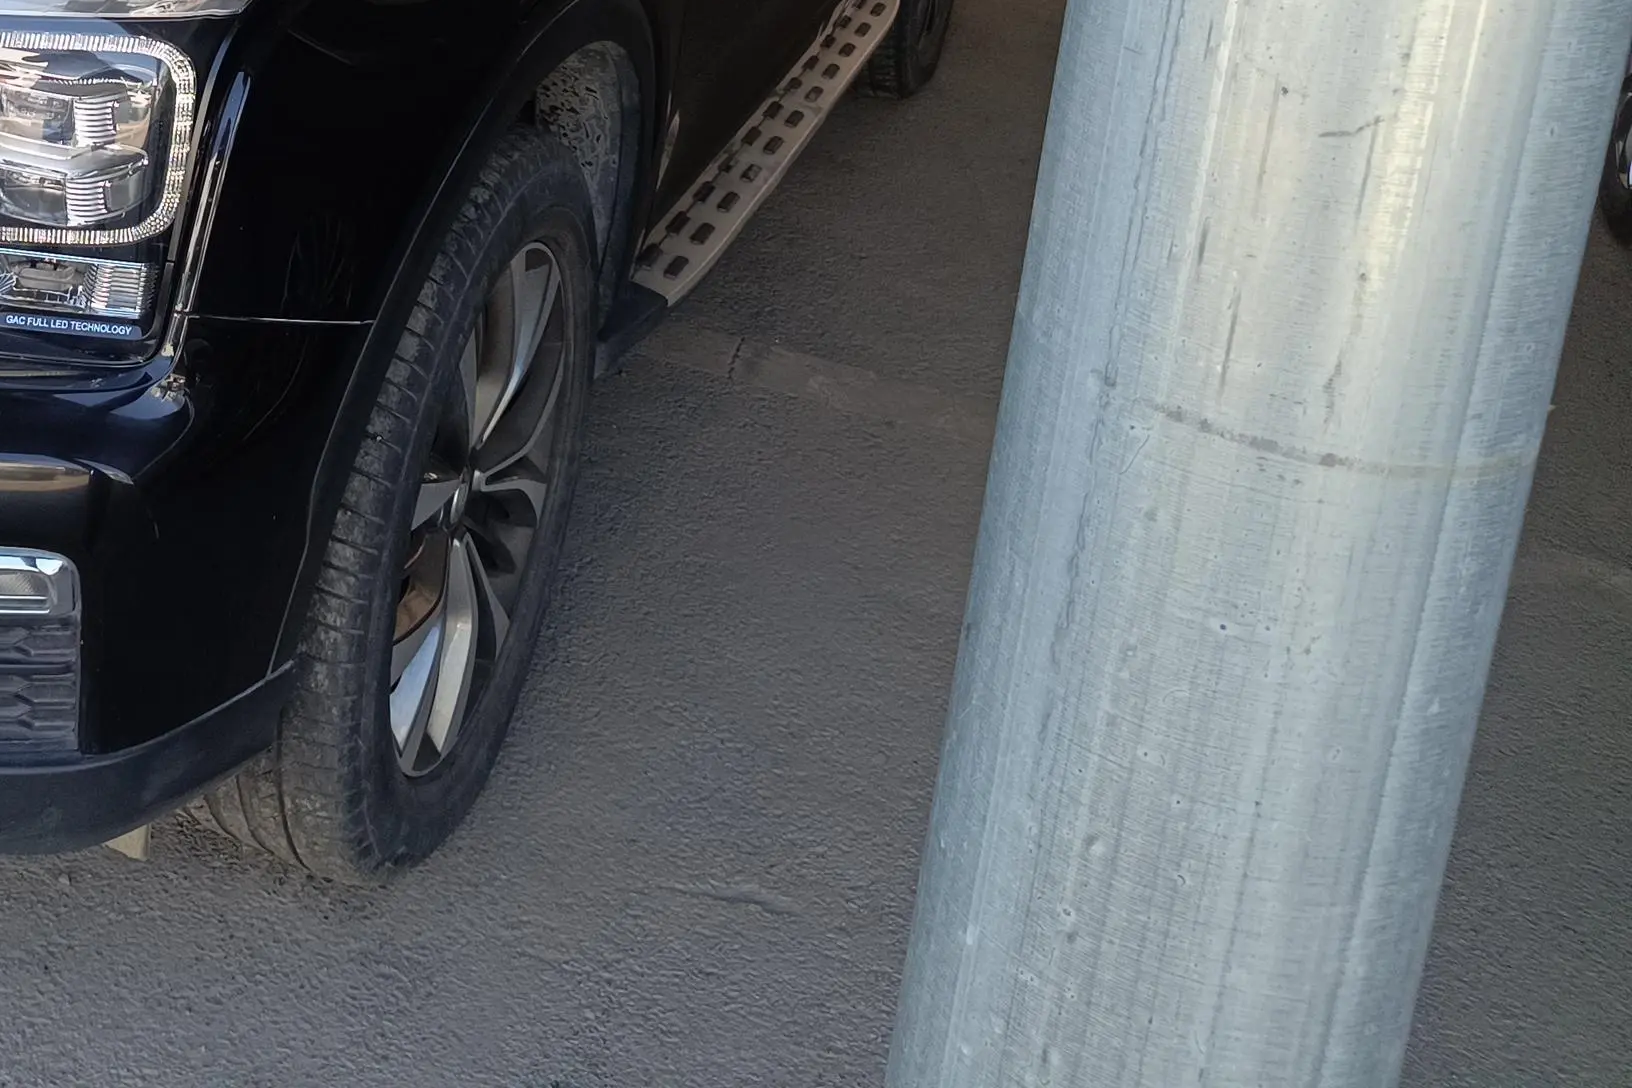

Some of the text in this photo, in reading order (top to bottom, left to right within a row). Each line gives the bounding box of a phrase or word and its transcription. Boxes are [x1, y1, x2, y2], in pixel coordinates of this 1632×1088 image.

[5, 315, 134, 336] GAC FULL LED TECHNOLOGY
